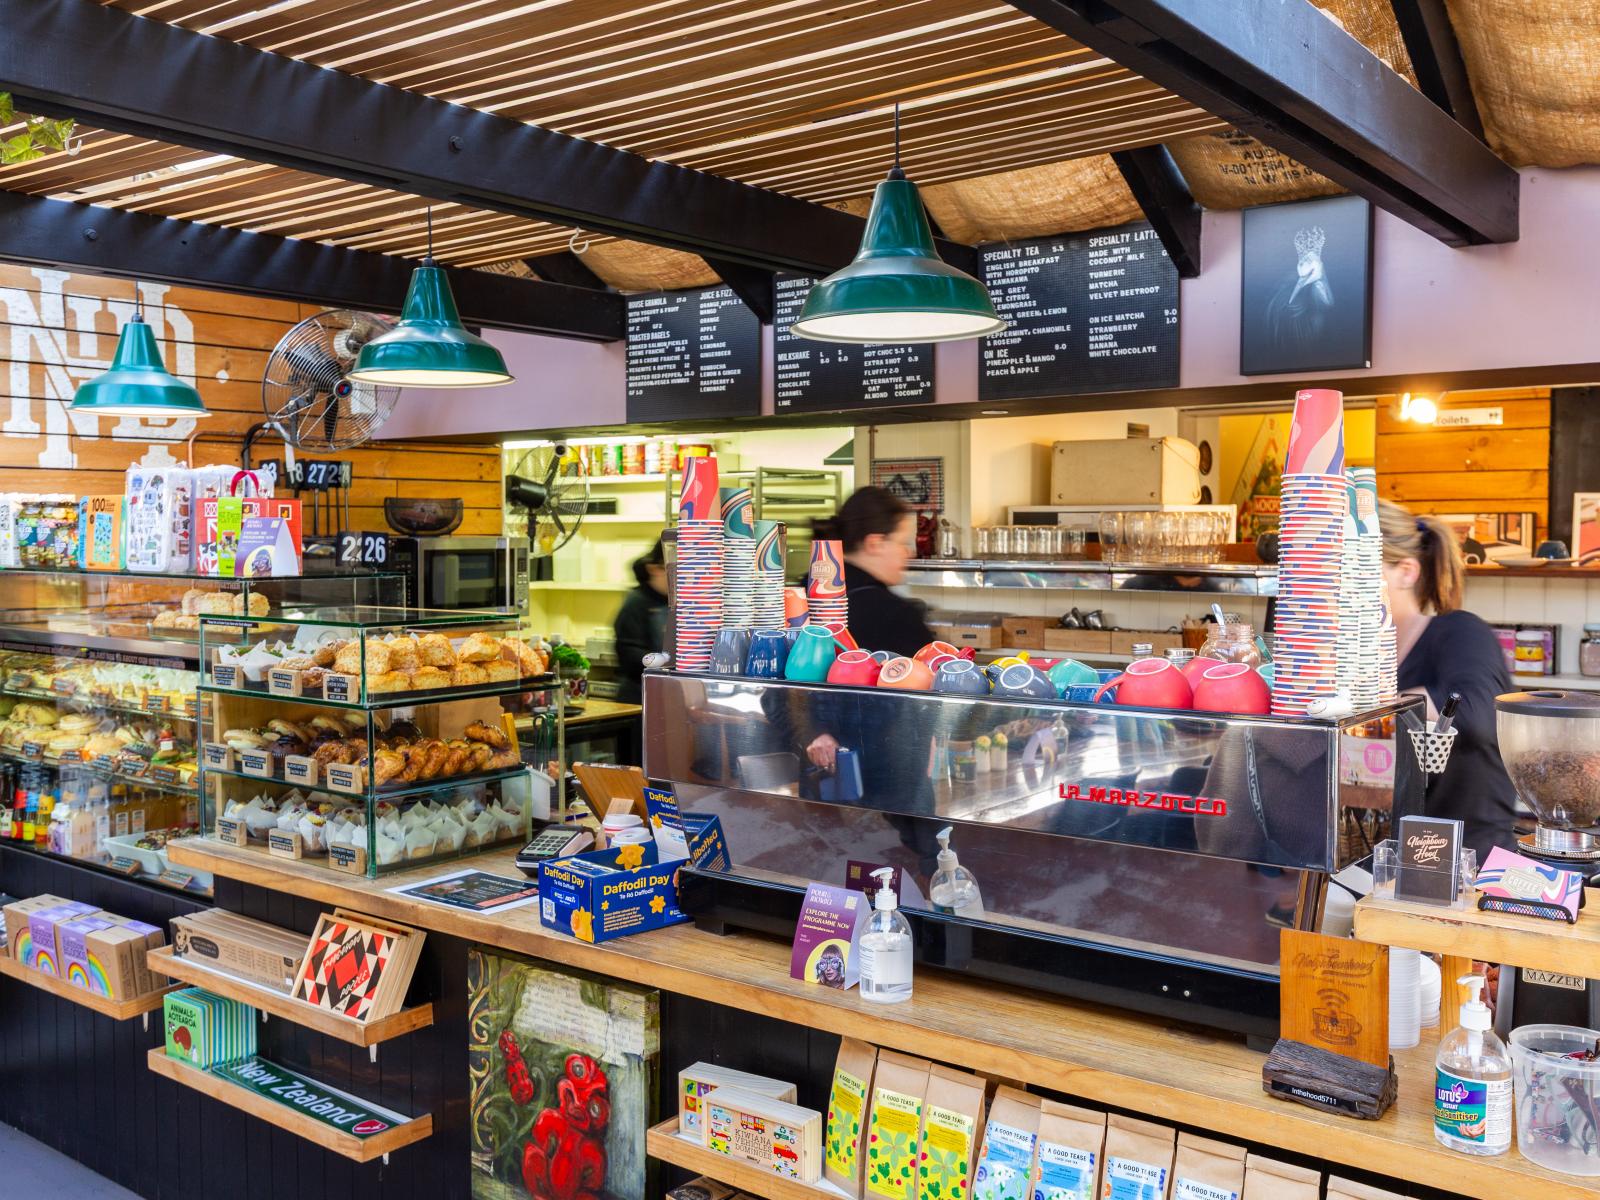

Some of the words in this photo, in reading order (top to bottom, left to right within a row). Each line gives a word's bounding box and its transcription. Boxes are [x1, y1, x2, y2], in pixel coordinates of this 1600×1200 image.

[1089, 233, 1130, 248] SPECIALTY
[984, 248, 1021, 262] SPECIALTY
[1026, 246, 1039, 256] TEA
[1089, 250, 1108, 258] MADE
[1112, 246, 1130, 254] WITH
[986, 262, 1015, 272] ENGLISH
[1019, 256, 1060, 267] BREAKFAST
[1089, 256, 1123, 266] COCONUT
[1126, 253, 1144, 261] MILK
[1006, 266, 1040, 276] HOROPITO
[1089, 268, 1126, 279] TURMERIC
[776, 278, 810, 290] SMOOTHIES
[992, 276, 1028, 285] KAWAKAWA
[1089, 280, 1118, 290] MATCHA
[700, 292, 715, 300] JUICE
[720, 289, 732, 297] FIZZ
[1008, 286, 1026, 294] GREY
[1089, 291, 1118, 300] VELVET
[1120, 286, 1160, 296] BEETROOT
[777, 299, 806, 308] STRAWBER
[1006, 294, 1030, 302] CITRUS
[1043, 307, 1067, 316] LEMON
[1115, 312, 1144, 321] MATCHA
[1032, 324, 1071, 334] CHAMOMILE
[1089, 324, 1138, 334] STRAWBERRY
[629, 332, 650, 342] TOASTED
[651, 330, 670, 340] BAGELS
[993, 338, 1022, 346] ROSEHIP
[1089, 334, 1114, 342] MANGO
[700, 342, 726, 350] LEMONADE
[1089, 342, 1118, 350] BANANA
[1089, 350, 1110, 358] WHITE
[1113, 346, 1157, 356] CHOCOLATE
[778, 351, 810, 362] MILKSHAKE
[864, 350, 876, 358] HOT
[877, 348, 893, 356] CHOC
[984, 350, 994, 359] ON
[997, 349, 1008, 358] ICE
[864, 358, 884, 366] EXTRA
[986, 357, 1024, 366] PINEAPPLE
[1026, 354, 1032, 363] &
[778, 372, 810, 380] RASPBERRY
[986, 368, 1008, 376] PEACH
[1010, 366, 1016, 374] &
[1017, 366, 1040, 374] APPLE
[778, 380, 810, 388] CHOCOLATE
[862, 376, 902, 386] ALTERNATIVE
[778, 390, 804, 398] CARAMEL
[864, 392, 888, 400] ALMOND
[308, 464, 328, 484] 27
[92, 498, 106, 512] 100
[364, 536, 386, 562] 26
[1059, 783, 1080, 800] LA
[648, 792, 676, 804] Daffodi
[1407, 834, 1448, 850] Neighbour
[1414, 846, 1441, 863] Hood
[544, 866, 570, 884] Daffodil
[572, 874, 584, 888] Day
[603, 876, 646, 896] Daffodil
[649, 874, 670, 887] Day
[634, 888, 654, 896] Daffodil
[806, 908, 828, 918] EXPLORE
[830, 912, 839, 920] THE
[804, 916, 836, 926] PROGRAMME
[837, 922, 850, 930] NOW
[1526, 971, 1581, 987] MAZZER
[171, 1004, 193, 1018] ANIMALS
[168, 1012, 196, 1028] AOTEAROA
[842, 1076, 850, 1084] GOOD
[850, 1079, 861, 1090] TEASE
[233, 1061, 282, 1086] New
[270, 1081, 366, 1124] Zealand
[1438, 1089, 1462, 1104] LOTUS
[886, 1095, 899, 1103] GOOD
[900, 1098, 914, 1107] TEASE
[1442, 1102, 1460, 1110] INSTANT
[938, 1112, 951, 1120] GOOD
[952, 1116, 966, 1125] TEASE
[1445, 1112, 1478, 1121] Sanitiser
[736, 1129, 772, 1147] KIWIANA
[1013, 1131, 1029, 1142] TEASE
[736, 1136, 772, 1154] VEHICLES
[736, 1144, 774, 1160] DOMINOES
[1053, 1149, 1069, 1158] GOOD
[1070, 1153, 1086, 1162] TEASE
[1123, 1164, 1140, 1173] GOOD
[1192, 1186, 1207, 1195] GOOD
[1209, 1191, 1227, 1200] TEASE
